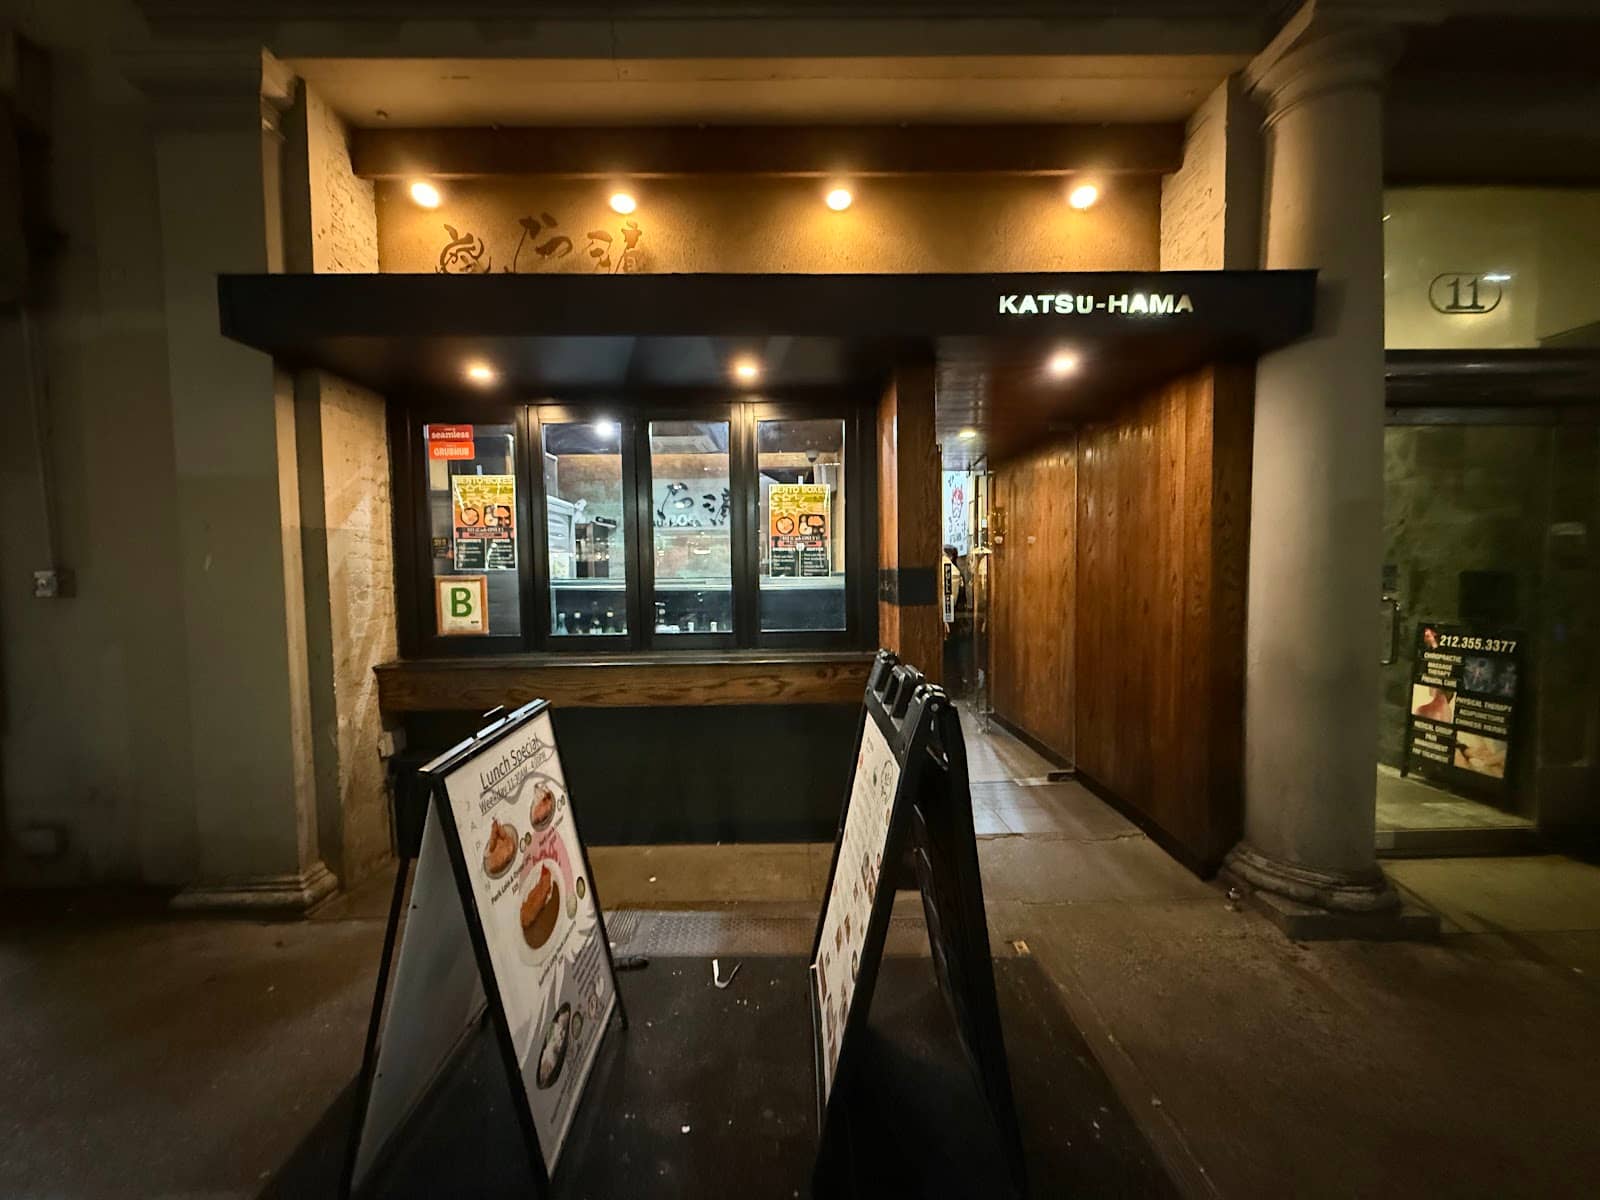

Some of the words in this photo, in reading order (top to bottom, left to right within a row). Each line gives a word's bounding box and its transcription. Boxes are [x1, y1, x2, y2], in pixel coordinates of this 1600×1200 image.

[999, 293, 1194, 314] KATSU-HAMA
[1446, 277, 1485, 310] 11
[431, 430, 470, 439] seamless
[451, 587, 472, 617] B
[1439, 634, 1517, 653] 212.355.3377
[480, 755, 511, 790] Lunch
[511, 732, 539, 767] Special
